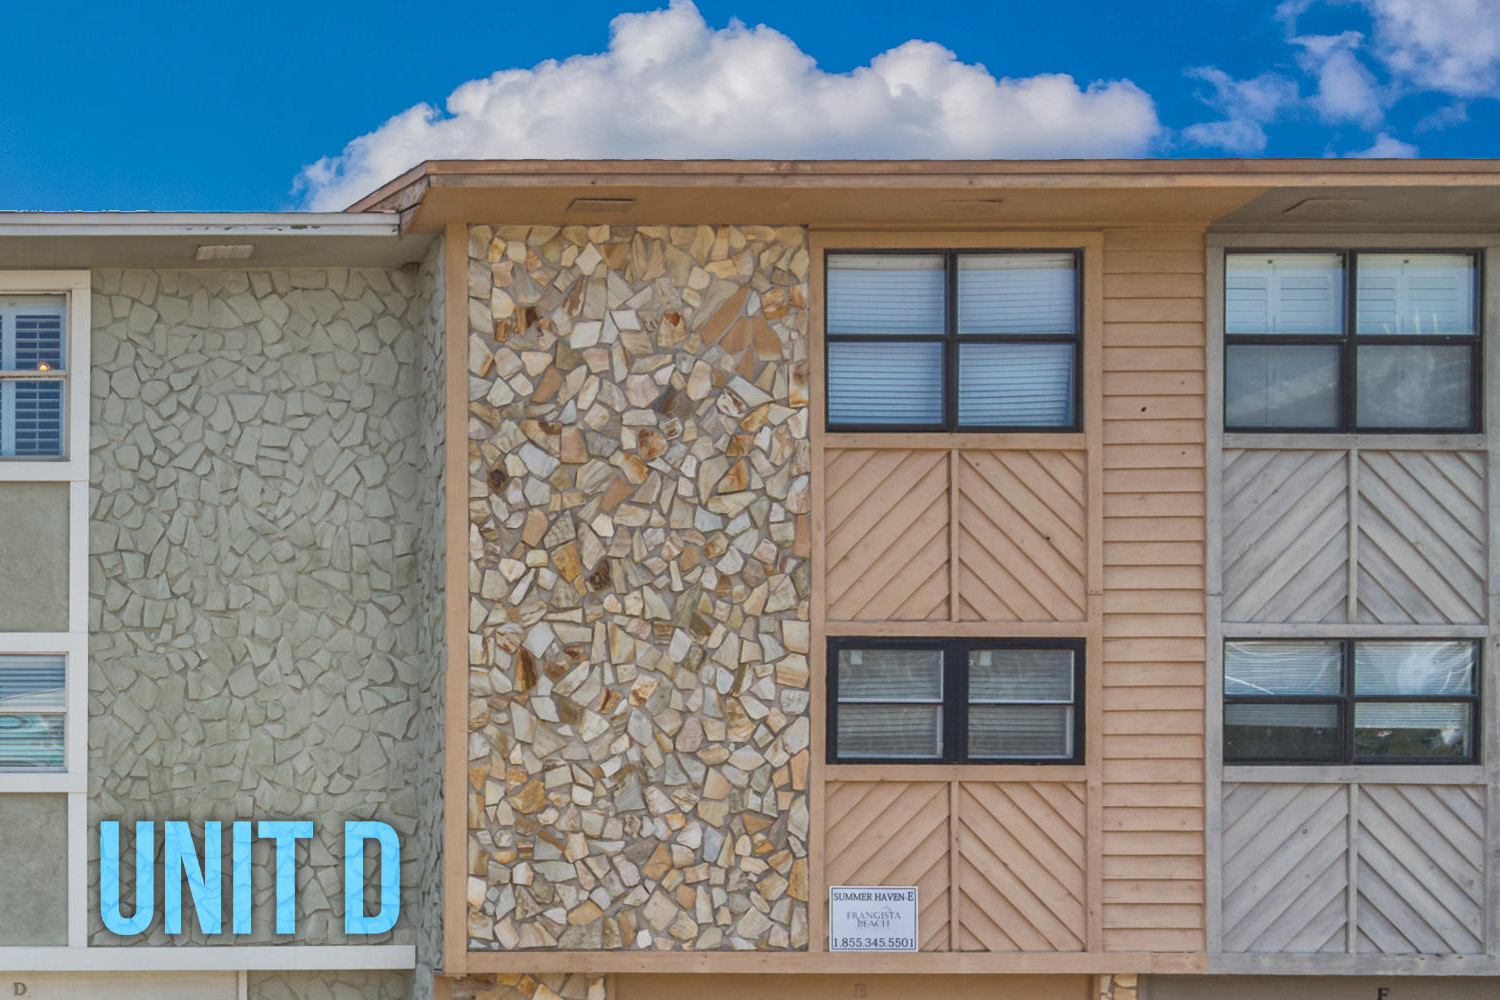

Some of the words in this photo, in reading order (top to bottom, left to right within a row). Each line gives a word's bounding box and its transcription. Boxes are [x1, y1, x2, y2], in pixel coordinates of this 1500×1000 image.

[834, 892, 872, 901] SUMMER
[846, 911, 901, 920] FRANGISTA
[857, 920, 890, 928] BEACH
[834, 938, 914, 948] 1.855.345.5501
[13, 981, 27, 996] D
